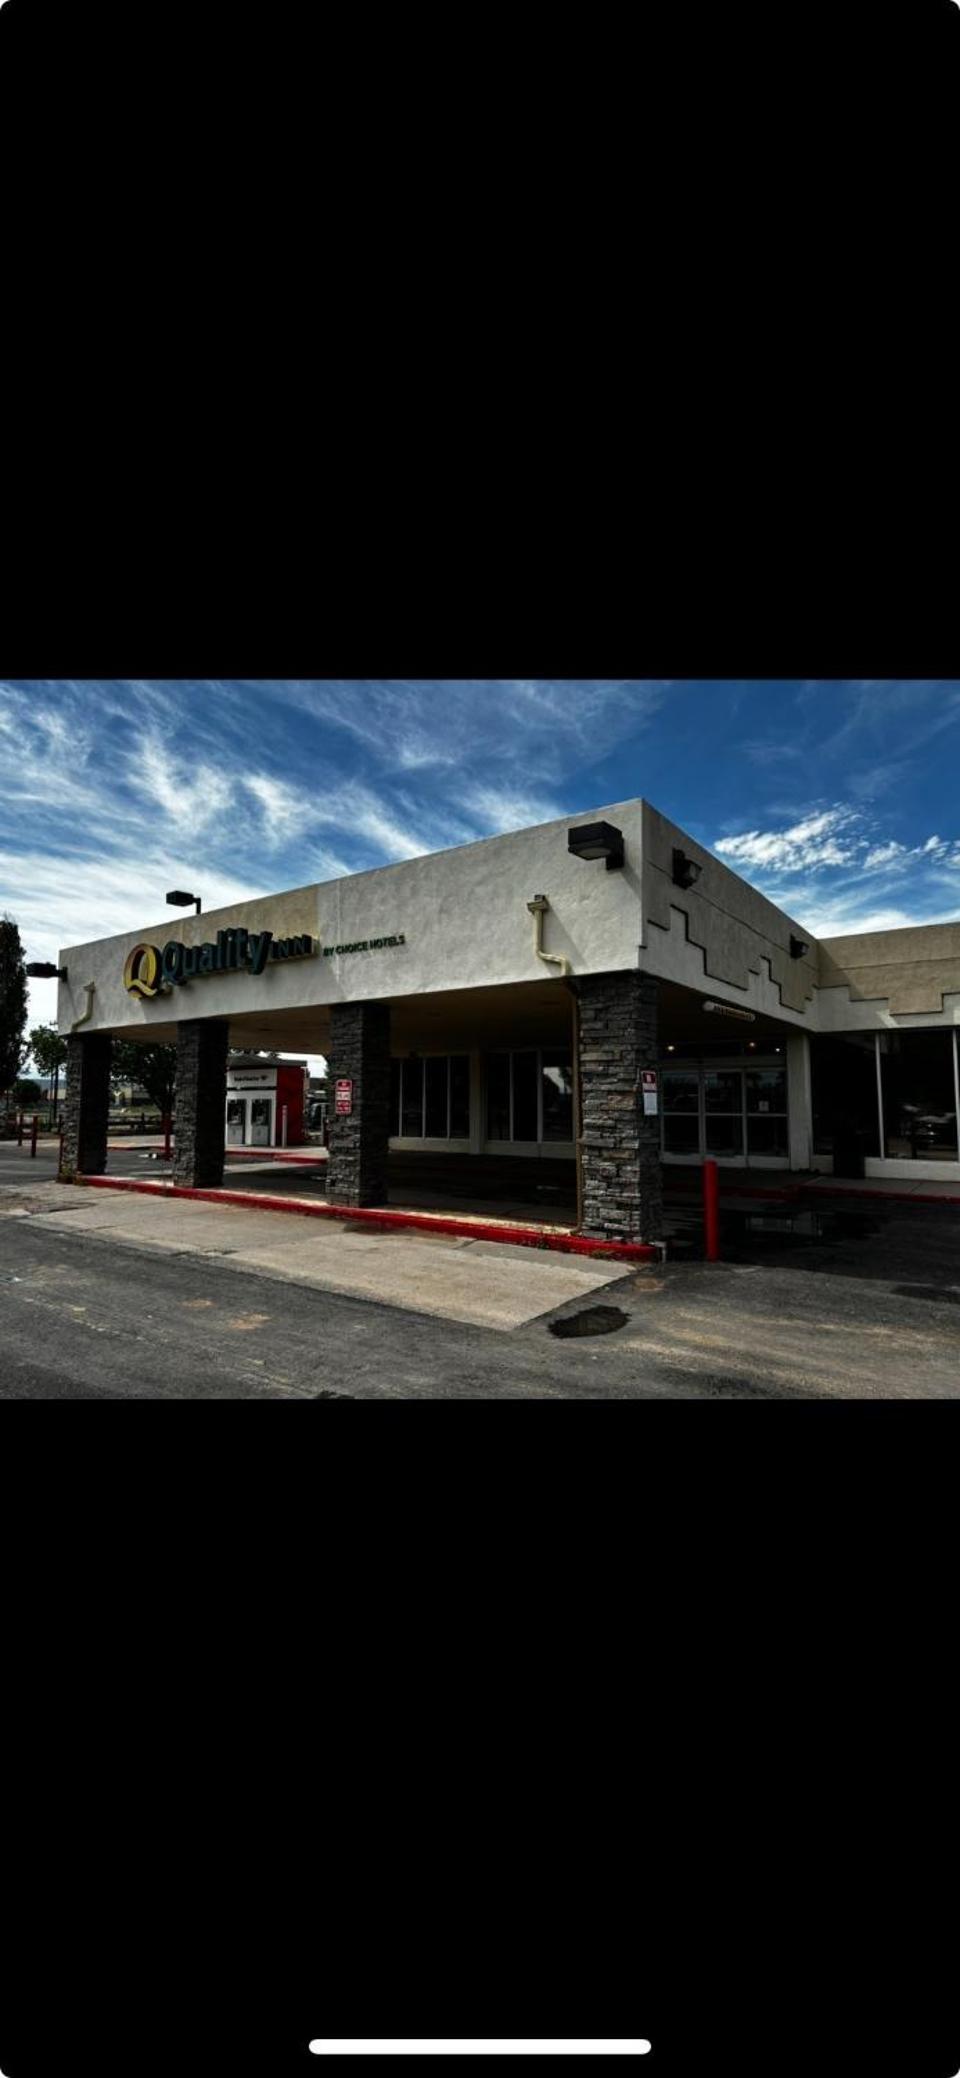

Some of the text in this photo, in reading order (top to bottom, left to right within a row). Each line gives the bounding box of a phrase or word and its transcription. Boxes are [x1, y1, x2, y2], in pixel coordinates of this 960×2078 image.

[163, 928, 273, 986] Quality
[271, 934, 313, 960] INN
[323, 934, 405, 957] BY CHOICE HOTELS
